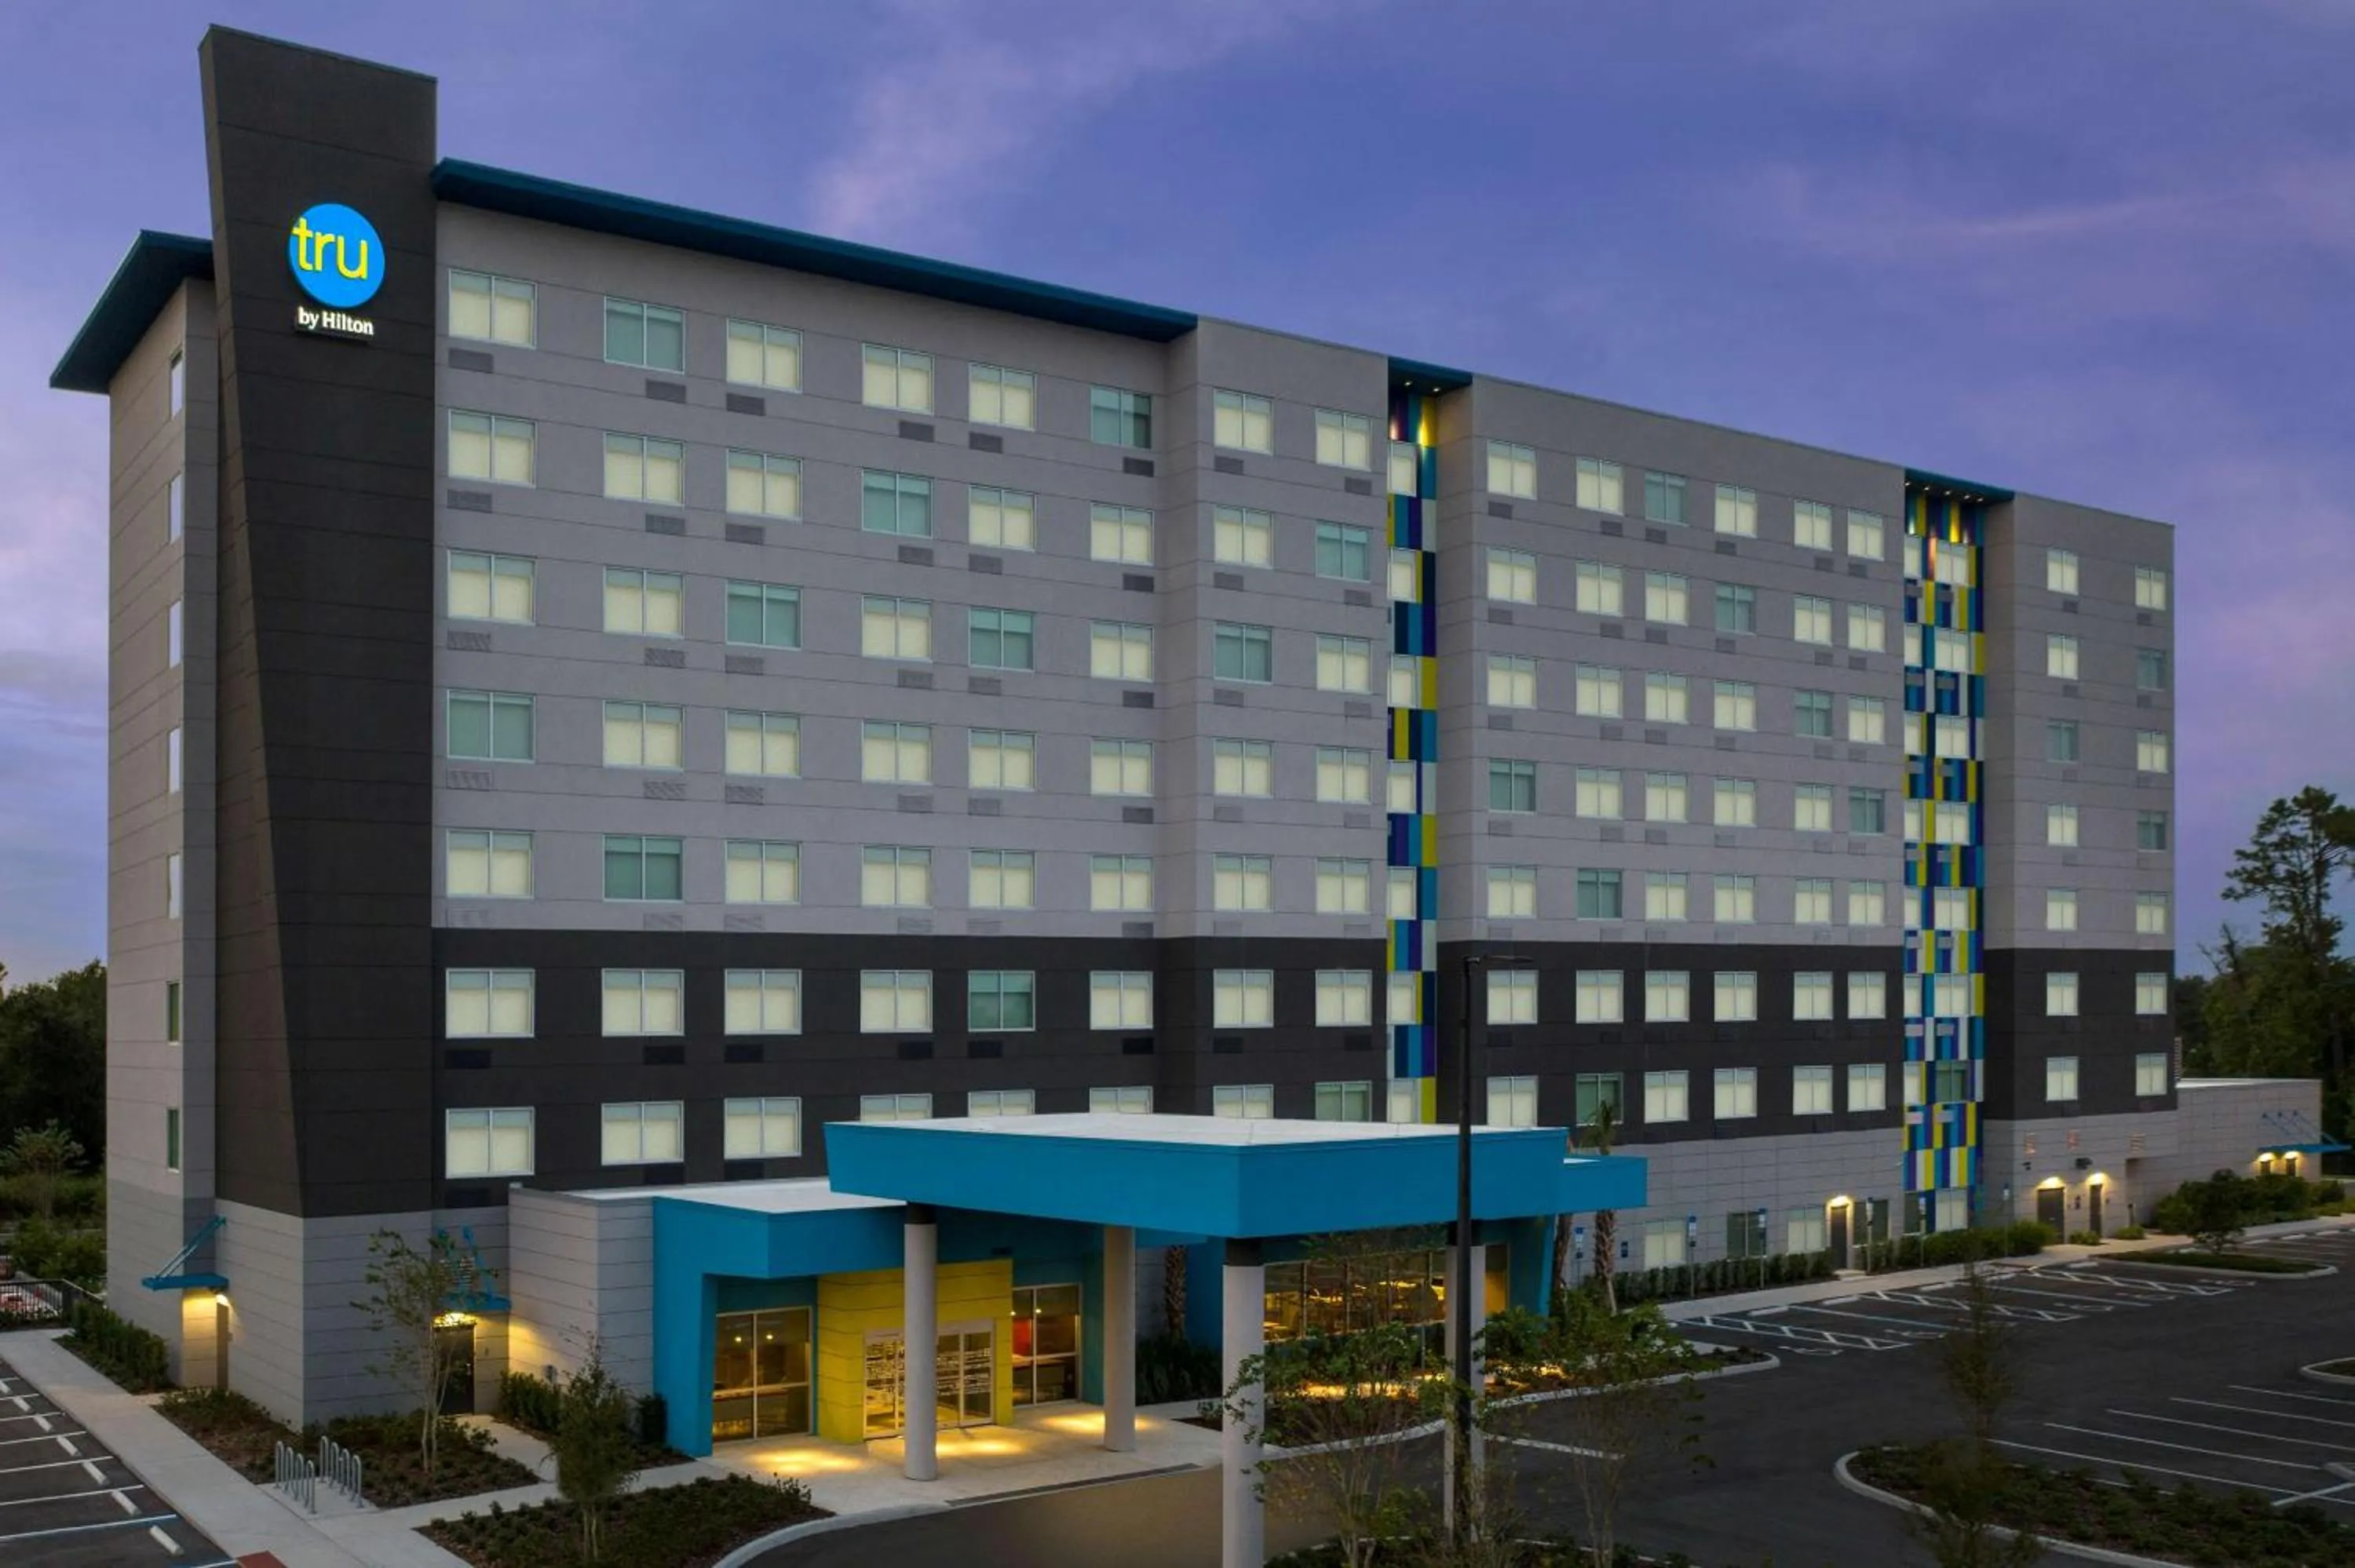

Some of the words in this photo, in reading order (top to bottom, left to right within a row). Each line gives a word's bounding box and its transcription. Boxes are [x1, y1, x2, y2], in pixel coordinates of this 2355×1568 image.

[292, 217, 368, 280] tru
[298, 305, 319, 330] by
[323, 310, 374, 335] Hilton
